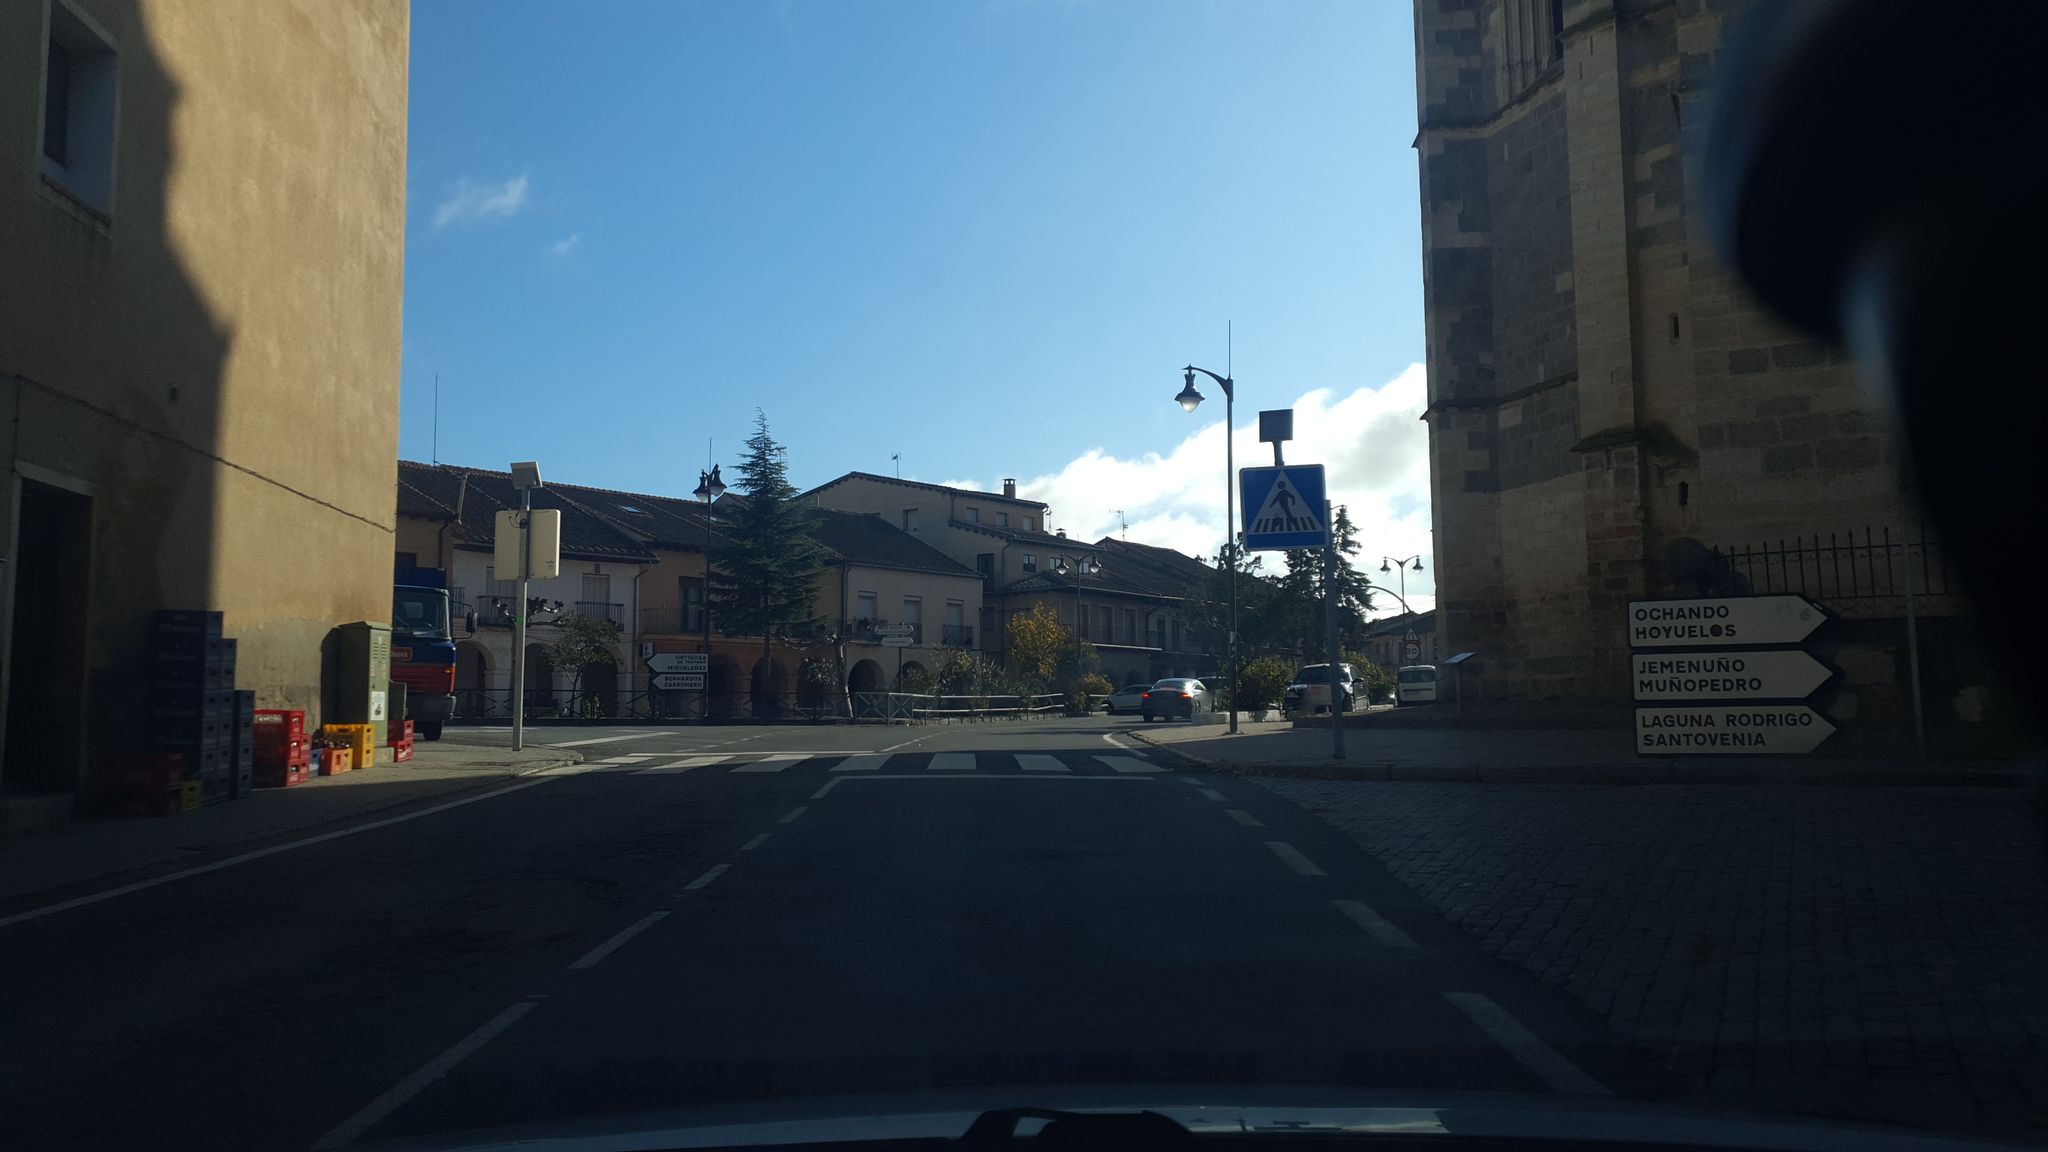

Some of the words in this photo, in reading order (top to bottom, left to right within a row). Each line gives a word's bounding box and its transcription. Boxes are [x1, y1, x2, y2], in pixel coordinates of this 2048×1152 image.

[1635, 605, 1730, 621] OCHANDO
[1635, 624, 1737, 640] HOYUELOS
[1639, 656, 1745, 674] JEMENUÑO
[1639, 676, 1762, 693] MUÑOPEDRO
[1641, 713, 1715, 728] LAGUNA
[1725, 712, 1813, 727] RODRIGO
[1643, 732, 1766, 747] SANTOVENIA
